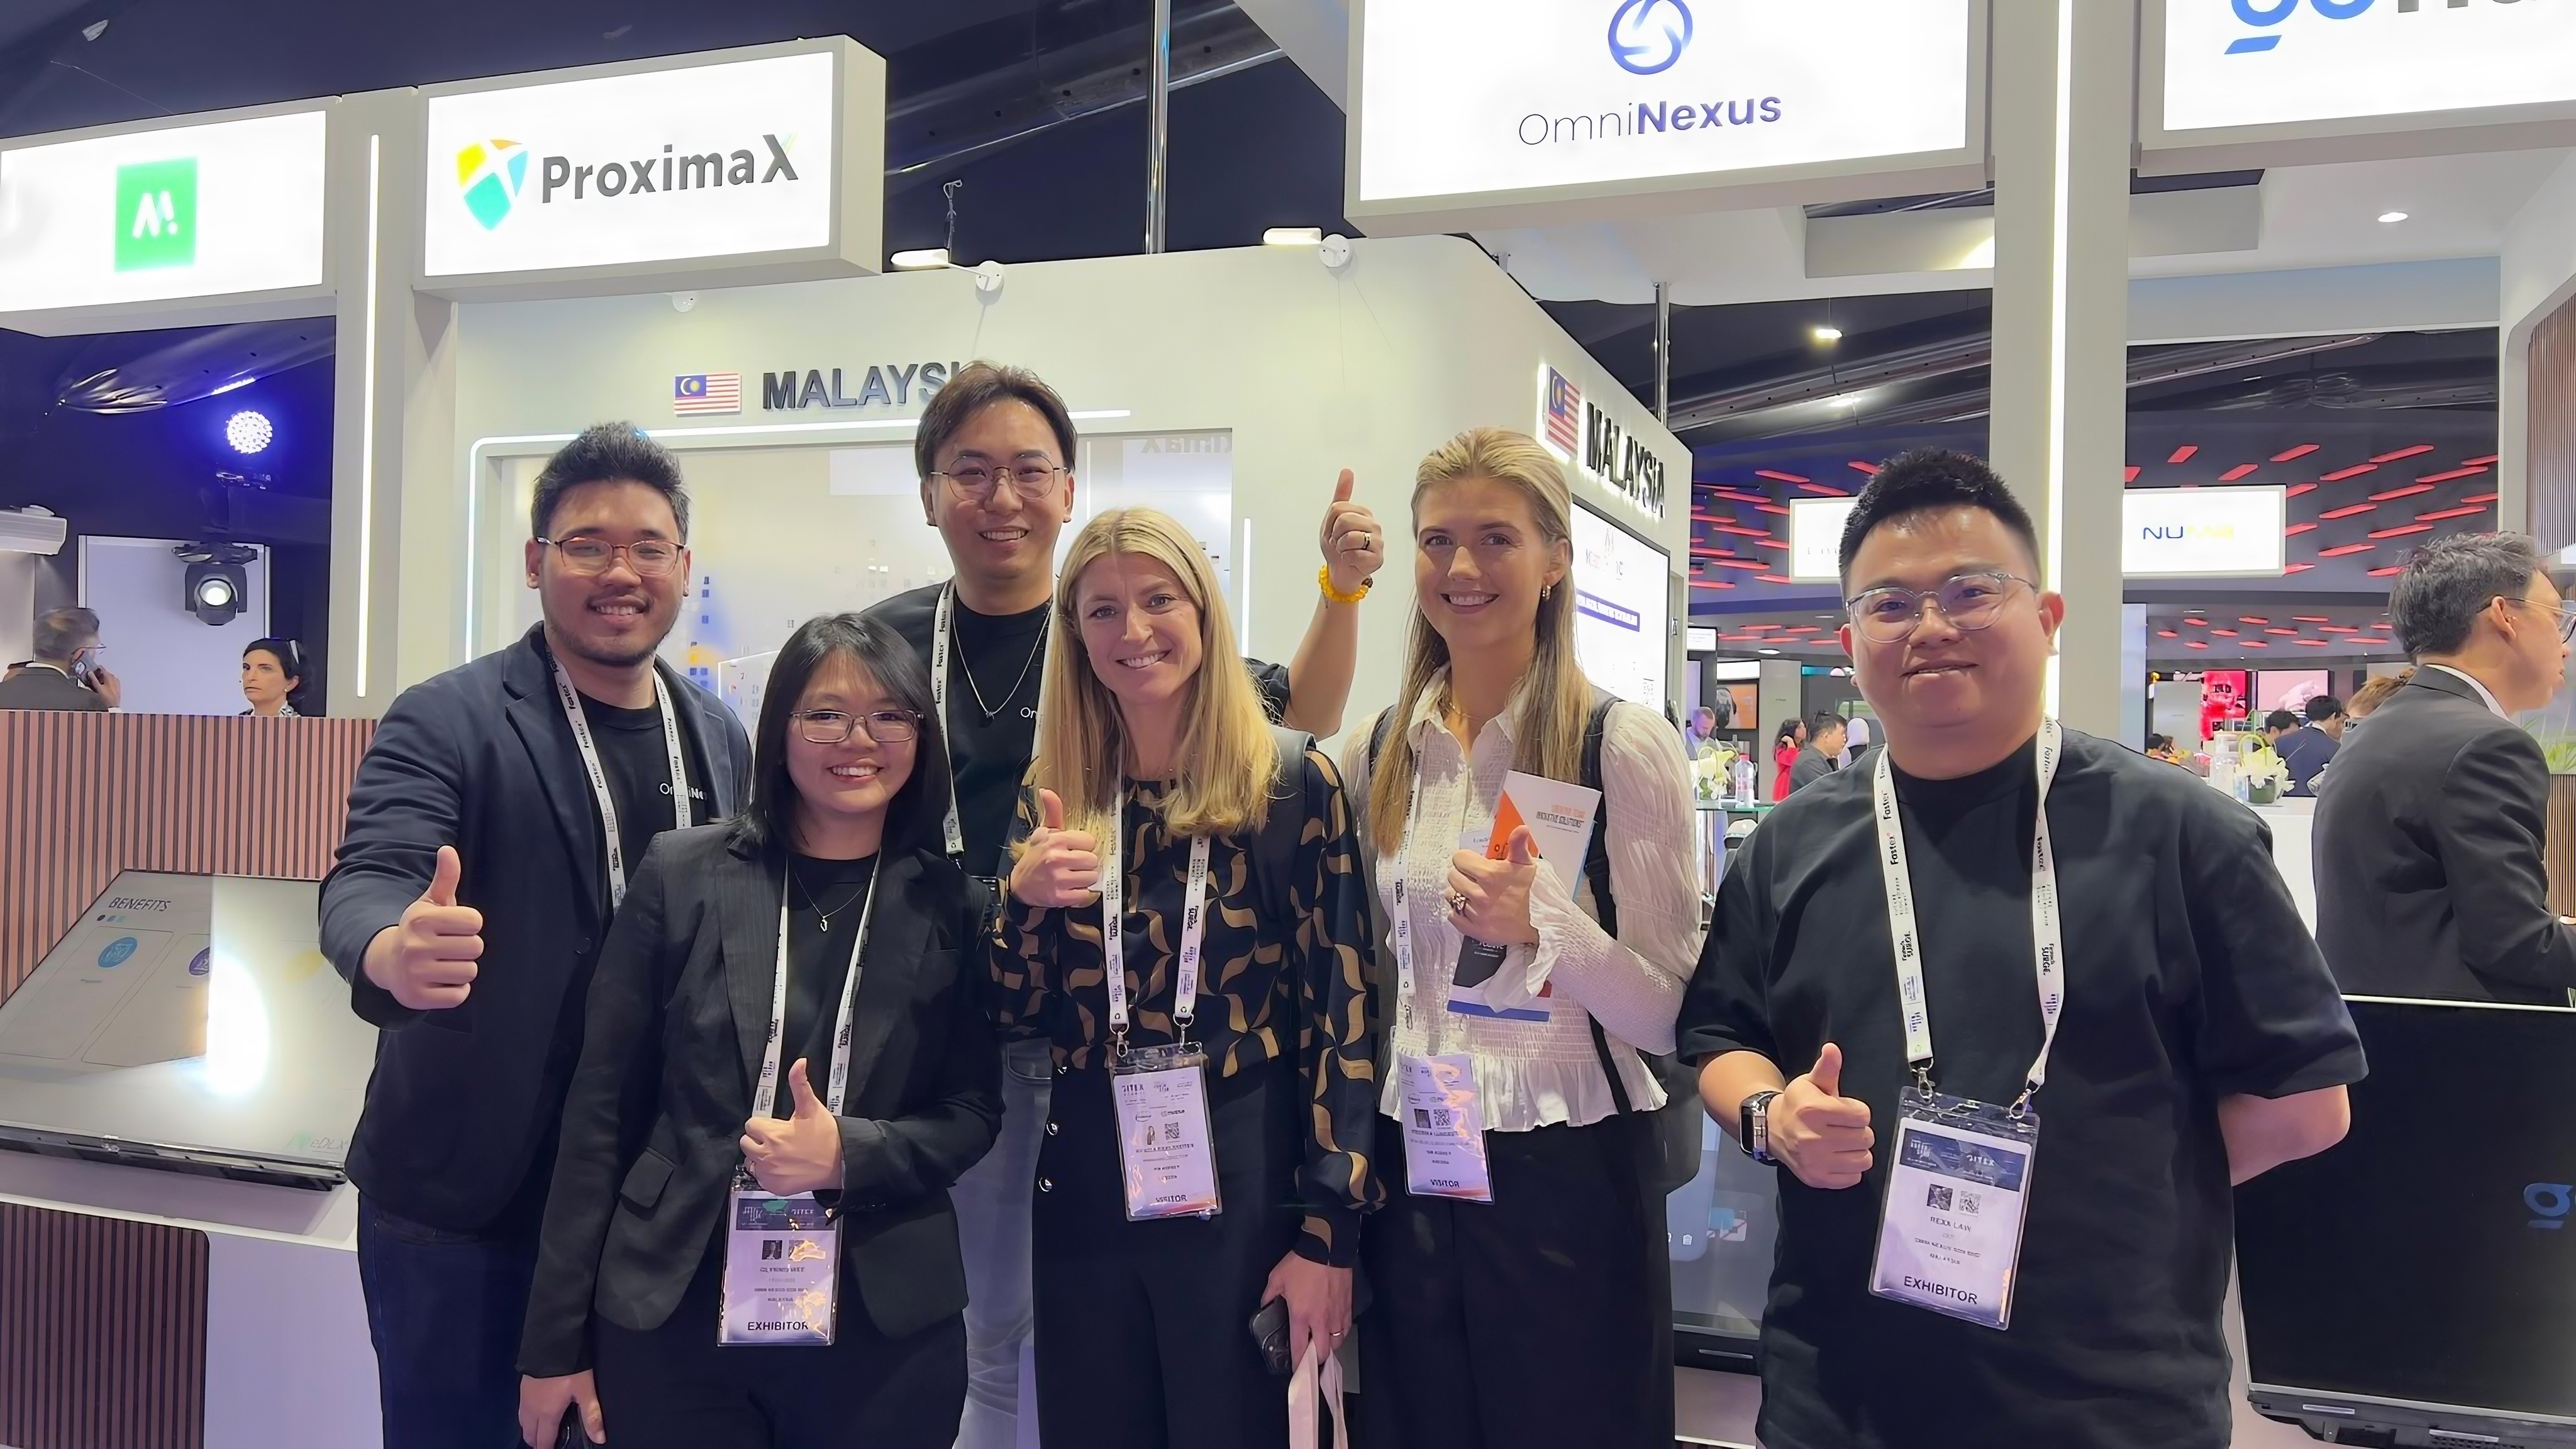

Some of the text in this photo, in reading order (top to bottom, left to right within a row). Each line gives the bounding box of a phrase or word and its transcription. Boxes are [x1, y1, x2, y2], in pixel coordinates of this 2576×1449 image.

[1518, 96, 1782, 145] OmniNexus
[542, 132, 799, 204] ProximaX
[762, 362, 960, 410] MALAYS
[1585, 402, 1666, 518] MALAYSIA
[109, 897, 172, 912] BENEFITS
[1903, 1275, 1979, 1305] EXHIBITOR
[747, 1321, 809, 1331] EXHIBITOR
